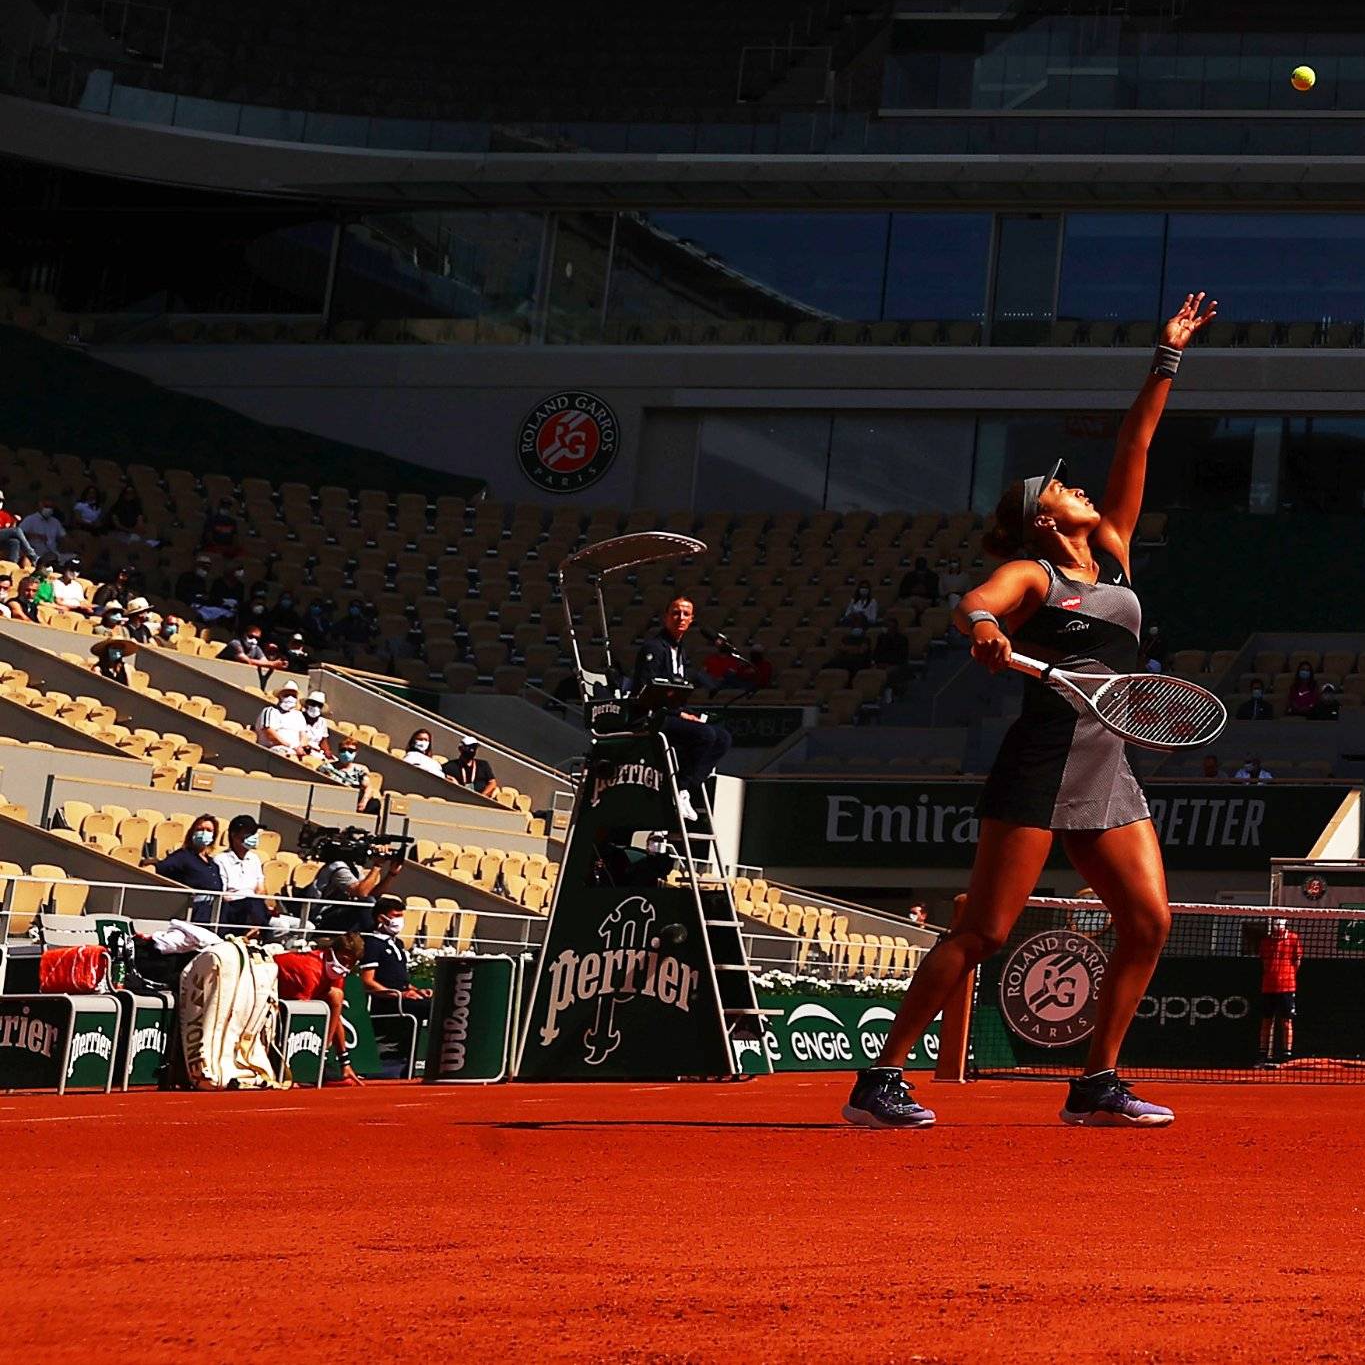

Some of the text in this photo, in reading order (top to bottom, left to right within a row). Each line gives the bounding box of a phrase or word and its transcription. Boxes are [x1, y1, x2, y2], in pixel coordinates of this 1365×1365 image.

[521, 396, 615, 453] ROLAND GARROS
[826, 794, 979, 843] Emira
[539, 936, 700, 1047] perrier
[1007, 937, 1059, 997] ROLAND
[440, 968, 473, 1074] Wilson
[1019, 1014, 1088, 1038] PARIS
[1137, 995, 1249, 1026] oppo
[68, 1026, 112, 1078] perrier
